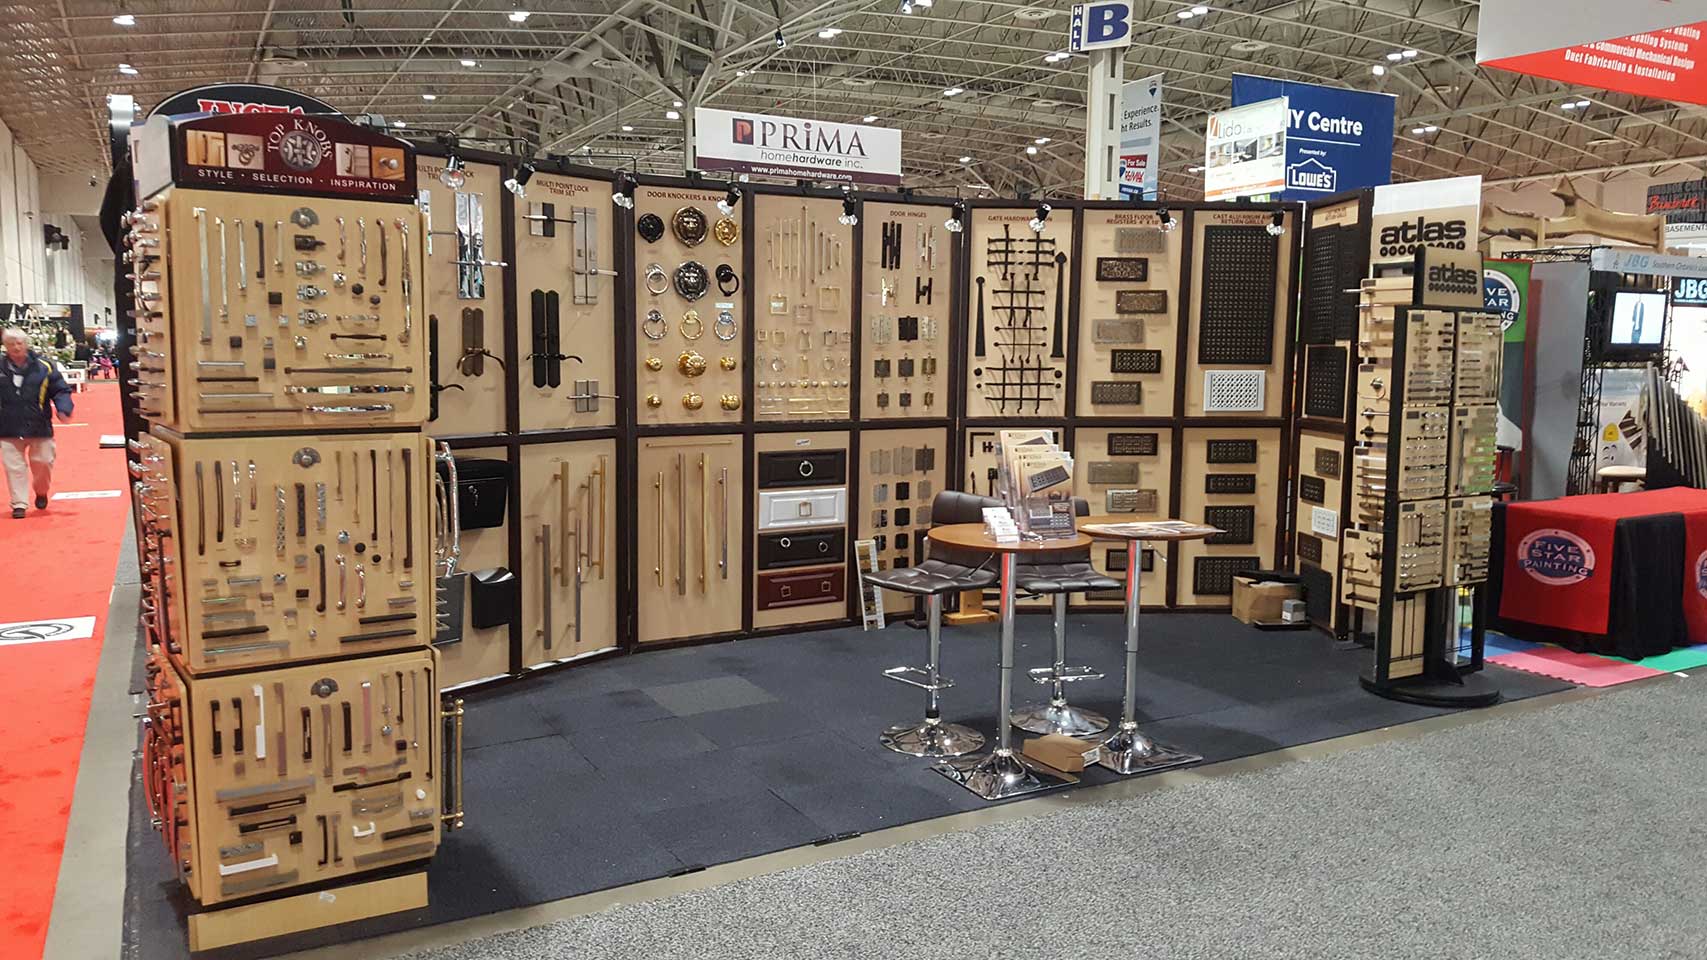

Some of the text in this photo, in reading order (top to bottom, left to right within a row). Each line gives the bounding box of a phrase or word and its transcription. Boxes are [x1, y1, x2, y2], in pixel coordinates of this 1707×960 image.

[1073, 5, 1083, 50] HALL
[1087, 4, 1129, 43] B
[1659, 37, 1688, 52] Systems
[1596, 42, 1635, 58] Commercial
[1635, 49, 1673, 65] Mechanical
[1672, 57, 1695, 69] Design
[1565, 49, 1676, 82] Duct Fabrication & Installation
[1123, 104, 1160, 120] Experience.
[1129, 120, 1152, 132] Results.
[1308, 111, 1363, 136] Centre
[267, 119, 333, 158] TOP KNOBS
[760, 149, 863, 169] homehardware inc.
[418, 165, 434, 173] ULTI
[751, 166, 852, 181] www.primahomehardware.com
[198, 168, 397, 191] STYLE SELECTION INSPIRATION
[536, 179, 590, 193] MULTI POINT LOCK
[1292, 169, 1332, 189] LOWE'S
[549, 187, 576, 197] TRIM SET
[667, 192, 701, 200] KNOCKERS
[1380, 216, 1466, 245] atlas
[1428, 262, 1478, 285] atlas
[1531, 549, 1582, 563] STAR
[1534, 540, 1580, 554] FIVE
[1523, 559, 1589, 576] PAINTING
